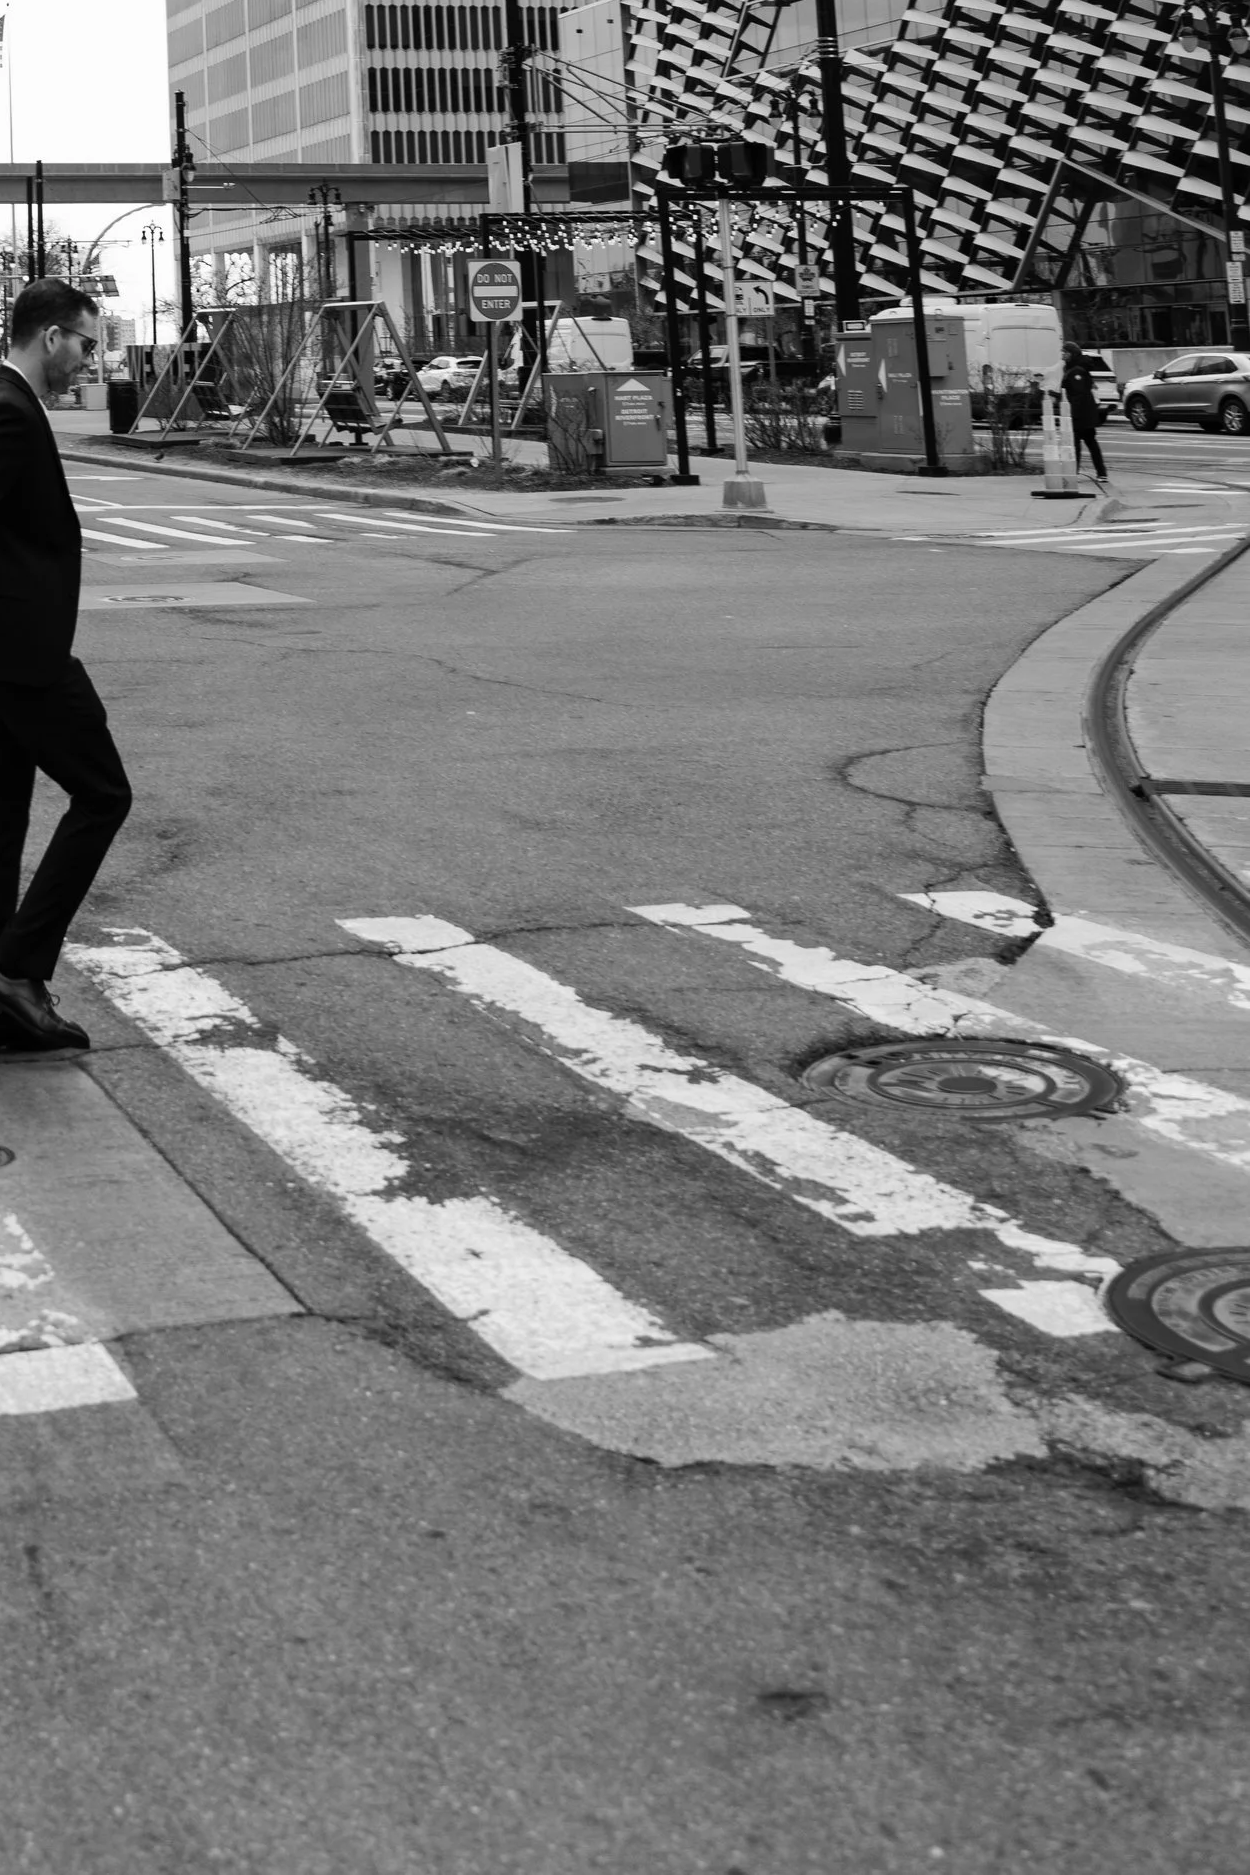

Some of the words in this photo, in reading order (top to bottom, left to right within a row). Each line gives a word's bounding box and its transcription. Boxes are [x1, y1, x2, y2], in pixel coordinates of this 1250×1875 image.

[476, 273, 490, 283] DO
[494, 273, 513, 283] NOT
[481, 299, 511, 309] ENTER
